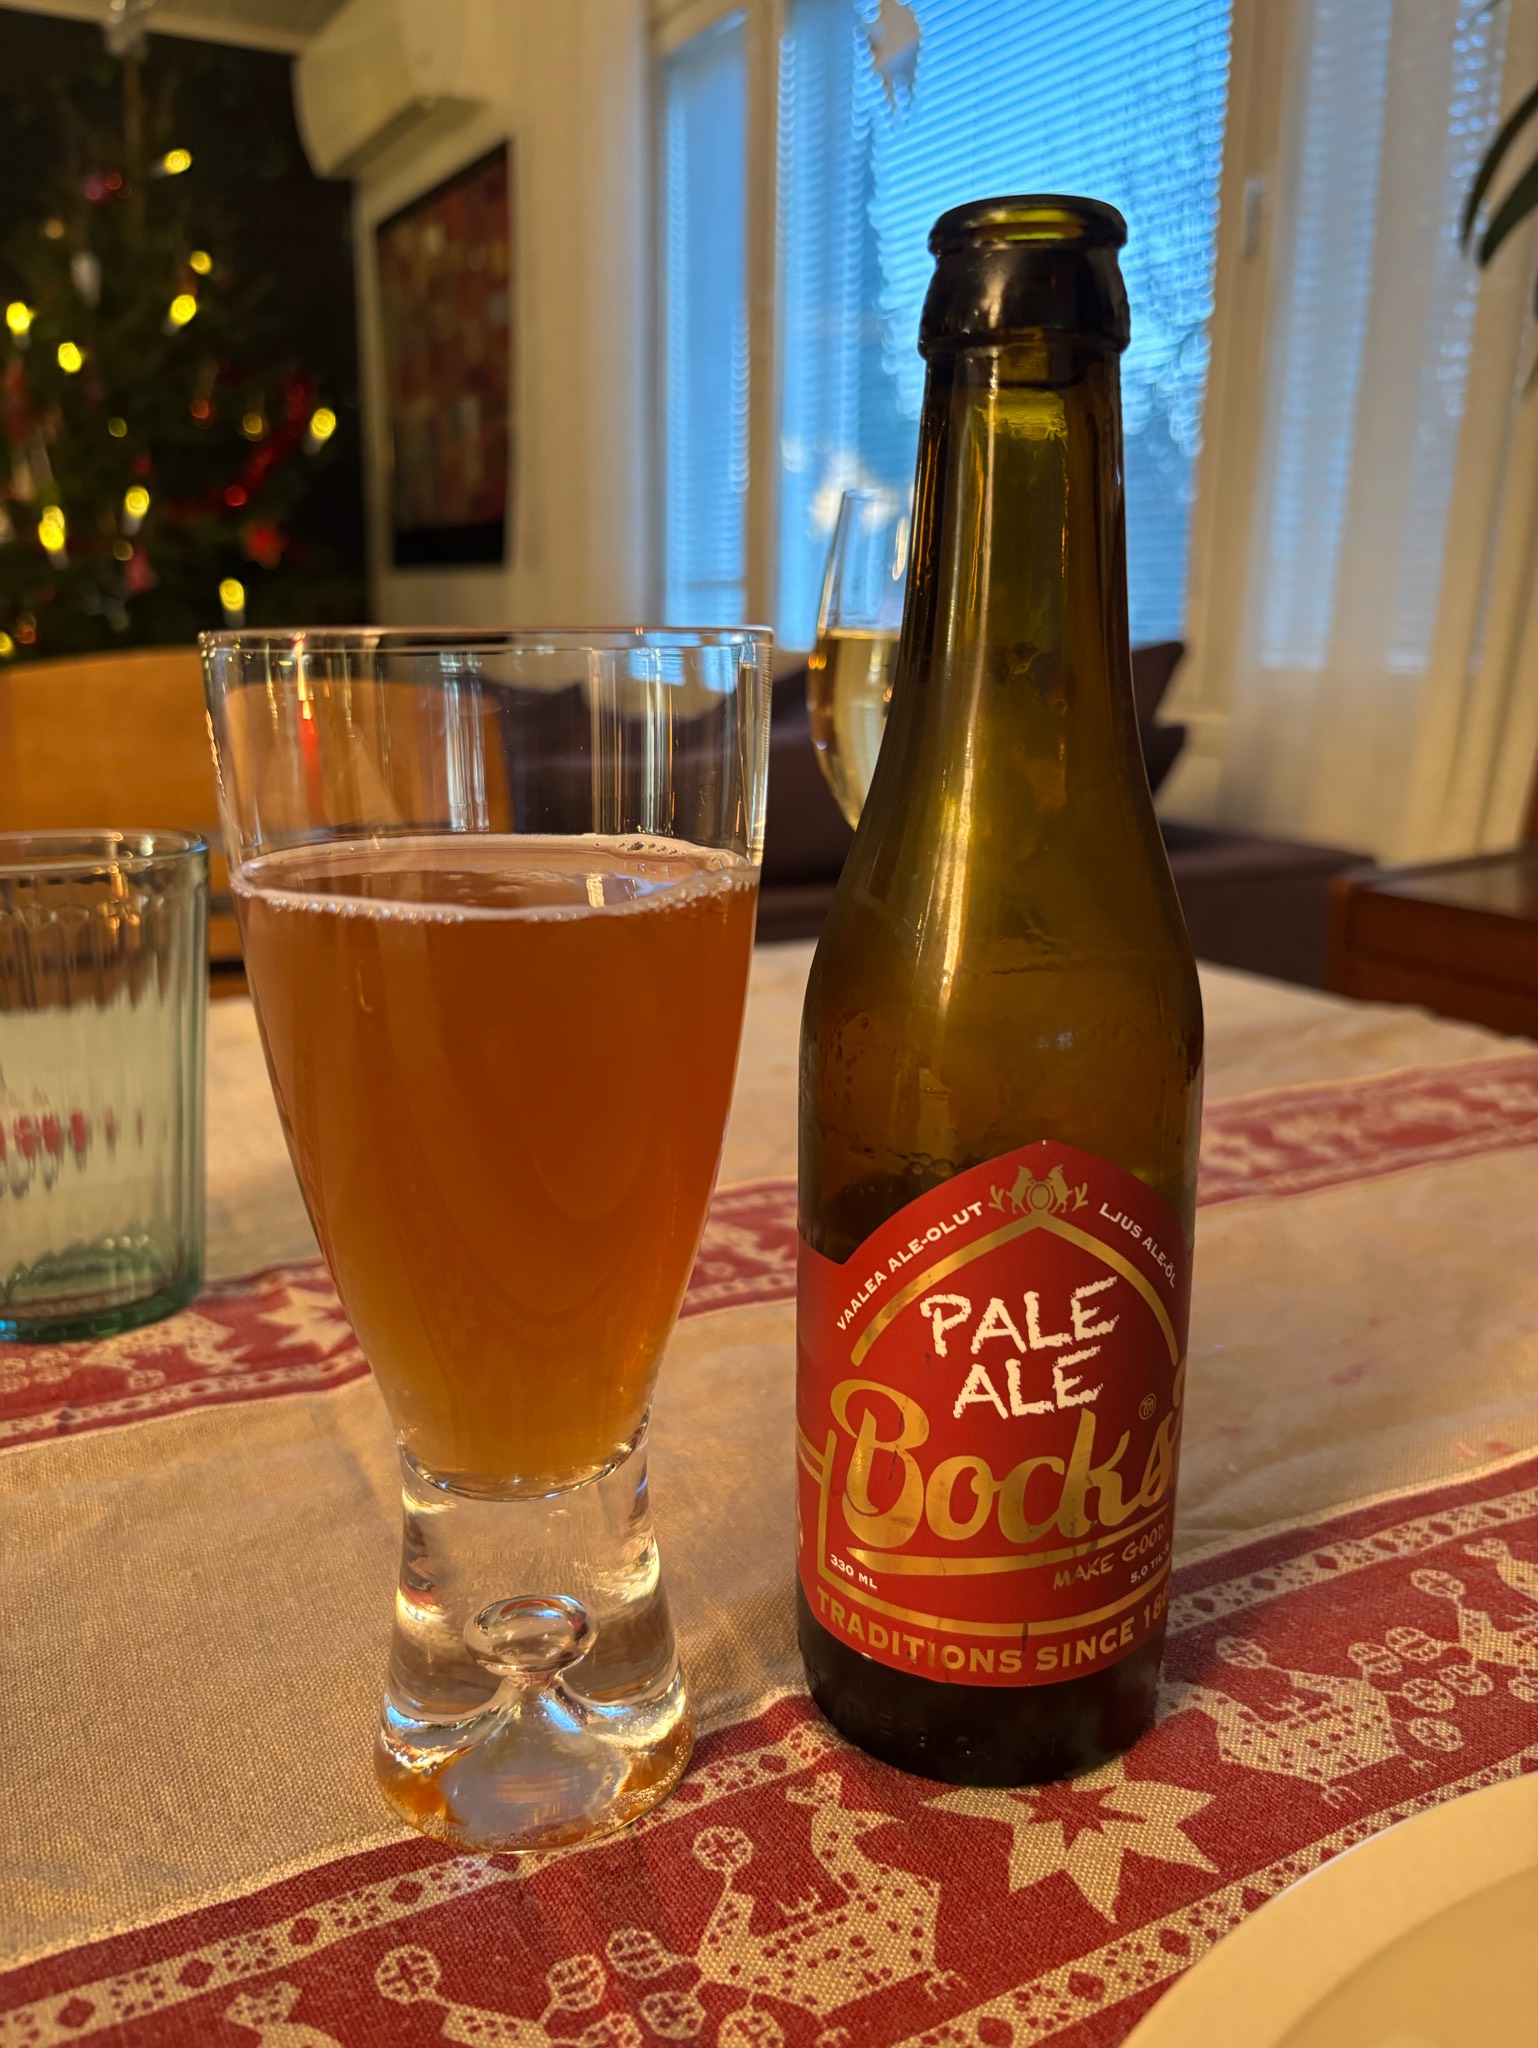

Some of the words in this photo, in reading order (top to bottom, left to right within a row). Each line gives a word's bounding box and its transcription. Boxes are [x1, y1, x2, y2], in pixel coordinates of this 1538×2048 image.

[836, 1270, 888, 1331] VAALEA
[887, 1201, 983, 1273] ALE-OLUT
[1099, 1202, 1143, 1238] LJUS
[1142, 1236, 1176, 1288] ALE-ÖL
[919, 1275, 1120, 1358] PALE
[953, 1345, 1104, 1419] ALE
[830, 1553, 855, 1577] 330
[858, 1571, 878, 1590] ML
[1053, 1552, 1115, 1590] MAKE
[816, 1584, 1023, 1674] TRADITIONS
[1036, 1615, 1135, 1671] SINCE
